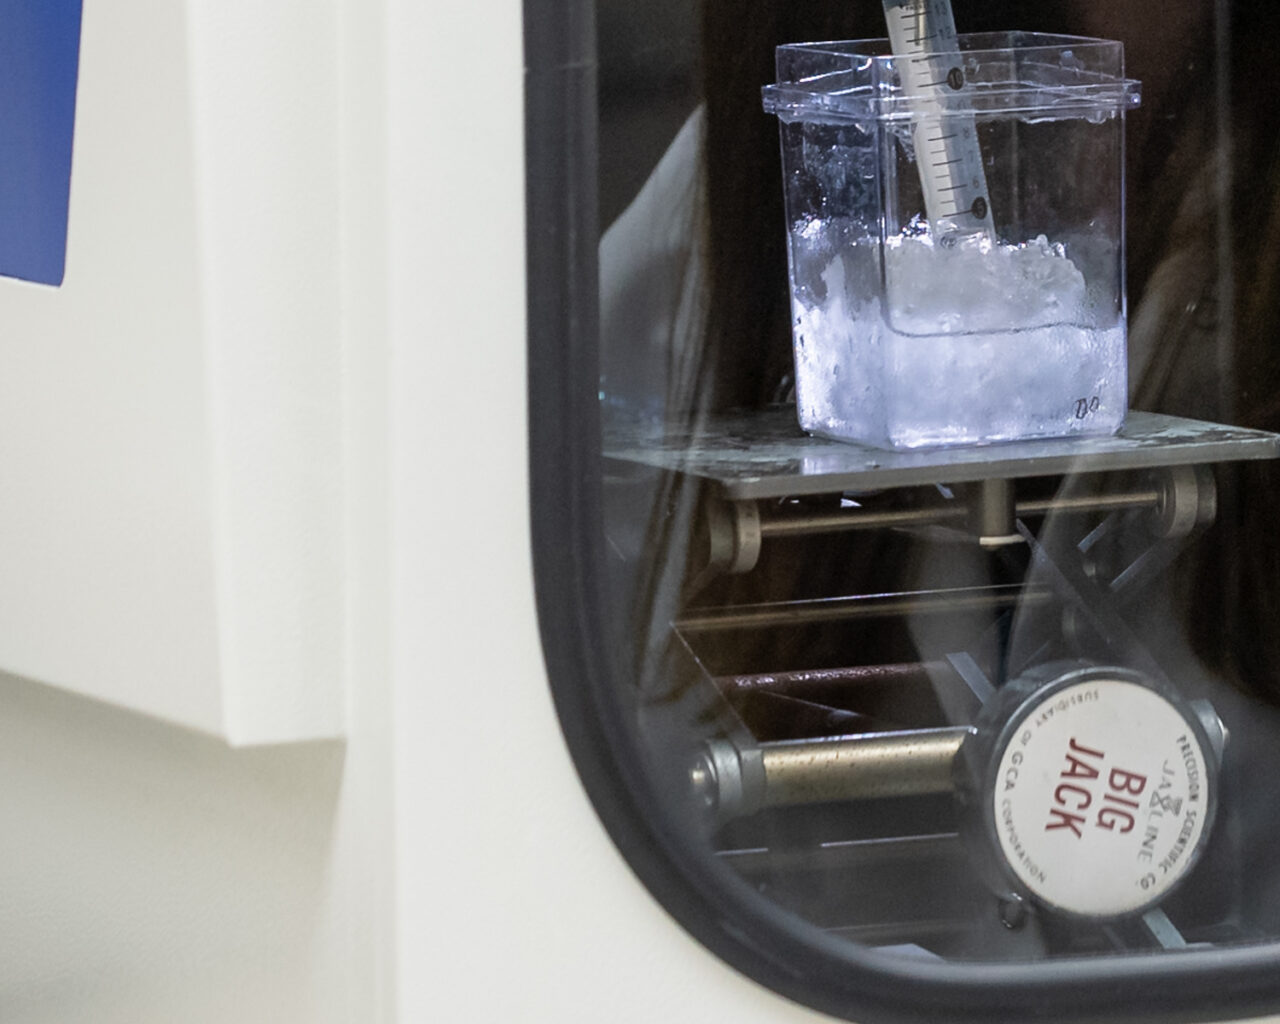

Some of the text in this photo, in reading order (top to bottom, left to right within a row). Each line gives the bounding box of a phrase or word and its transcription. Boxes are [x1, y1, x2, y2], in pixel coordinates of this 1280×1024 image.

[949, 69, 963, 89] 10
[1002, 689, 1099, 884] SUBSIDIARY OF GCA CORPORATION
[1044, 736, 1106, 840] JACK
[1096, 767, 1148, 835] BIG
[1176, 735, 1200, 802] PRECISION
[1158, 810, 1198, 874] SCIENTIFIC
